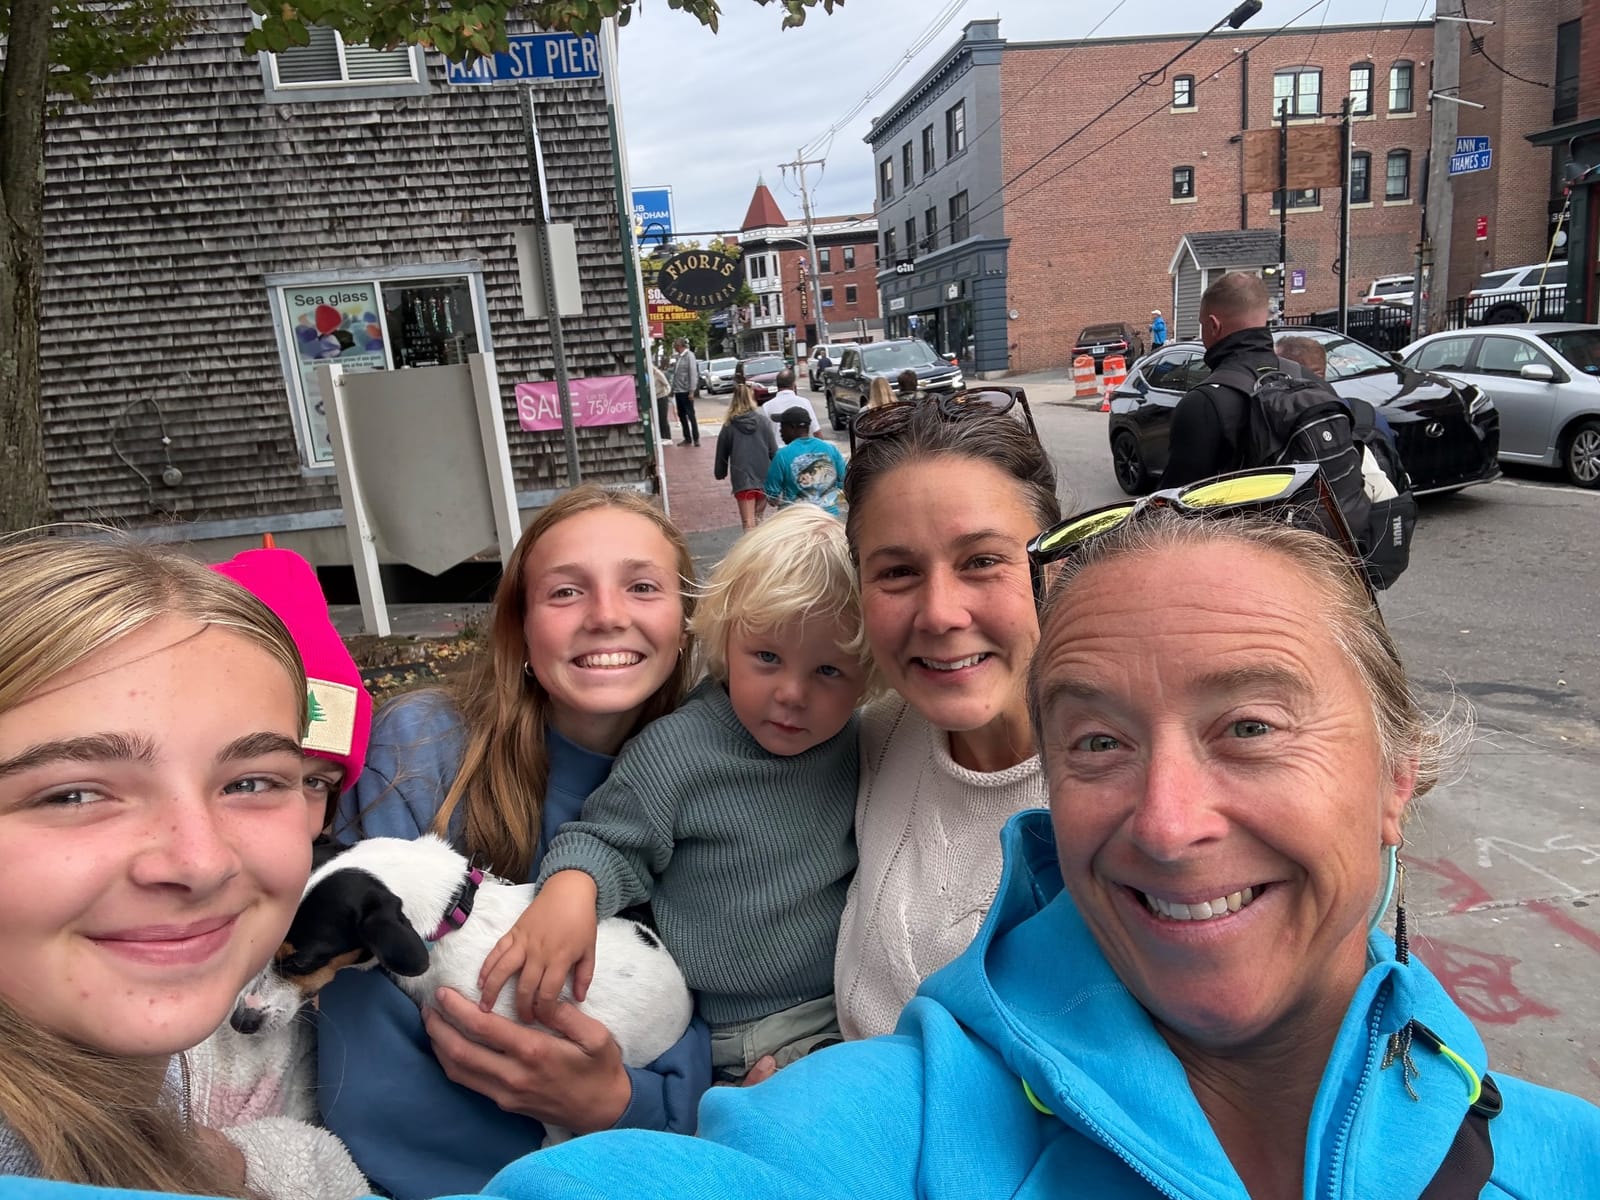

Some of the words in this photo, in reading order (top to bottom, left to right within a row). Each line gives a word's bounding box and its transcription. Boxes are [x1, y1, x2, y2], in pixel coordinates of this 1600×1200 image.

[509, 41, 534, 77] ST
[545, 37, 598, 74] PIER
[1456, 138, 1476, 153] ANN
[1478, 142, 1487, 151] ST
[1451, 154, 1479, 172] THAMES
[1481, 155, 1489, 168] ST
[665, 254, 735, 280] FLORI'S
[896, 262, 914, 273] Gill
[294, 293, 325, 307] Sea
[328, 290, 368, 307] glass
[520, 391, 582, 421] SALE
[1392, 515, 1402, 547] THULE
